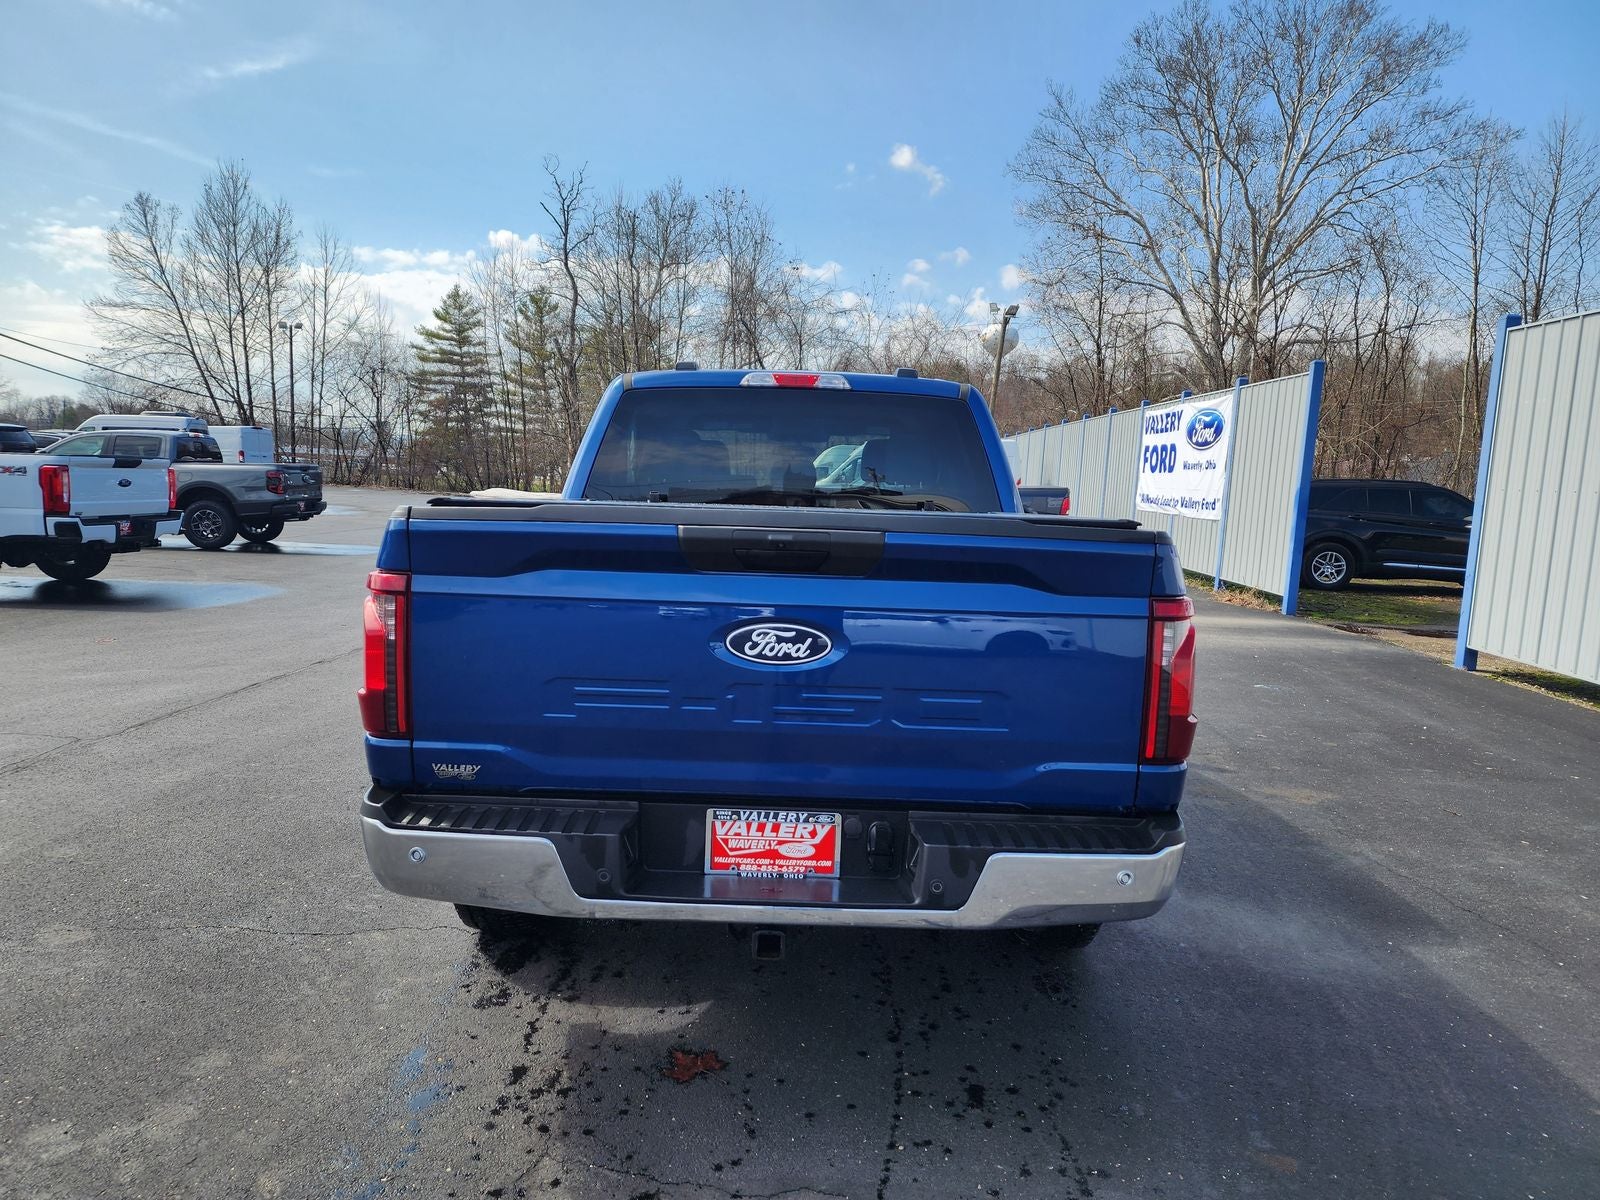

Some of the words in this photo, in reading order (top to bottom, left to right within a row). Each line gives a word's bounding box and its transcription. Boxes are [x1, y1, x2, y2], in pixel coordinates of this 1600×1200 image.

[1145, 409, 1184, 435] VALLERY
[1192, 415, 1218, 443] Ford
[1142, 443, 1177, 473] FORD
[1205, 459, 1216, 470] Ohio
[1180, 496, 1201, 512] Vallery
[744, 628, 813, 658] Ford
[431, 763, 481, 773] VALLERY
[740, 810, 808, 823] VALLERY
[714, 820, 832, 841] VALLERY
[785, 845, 809, 855] Ford
